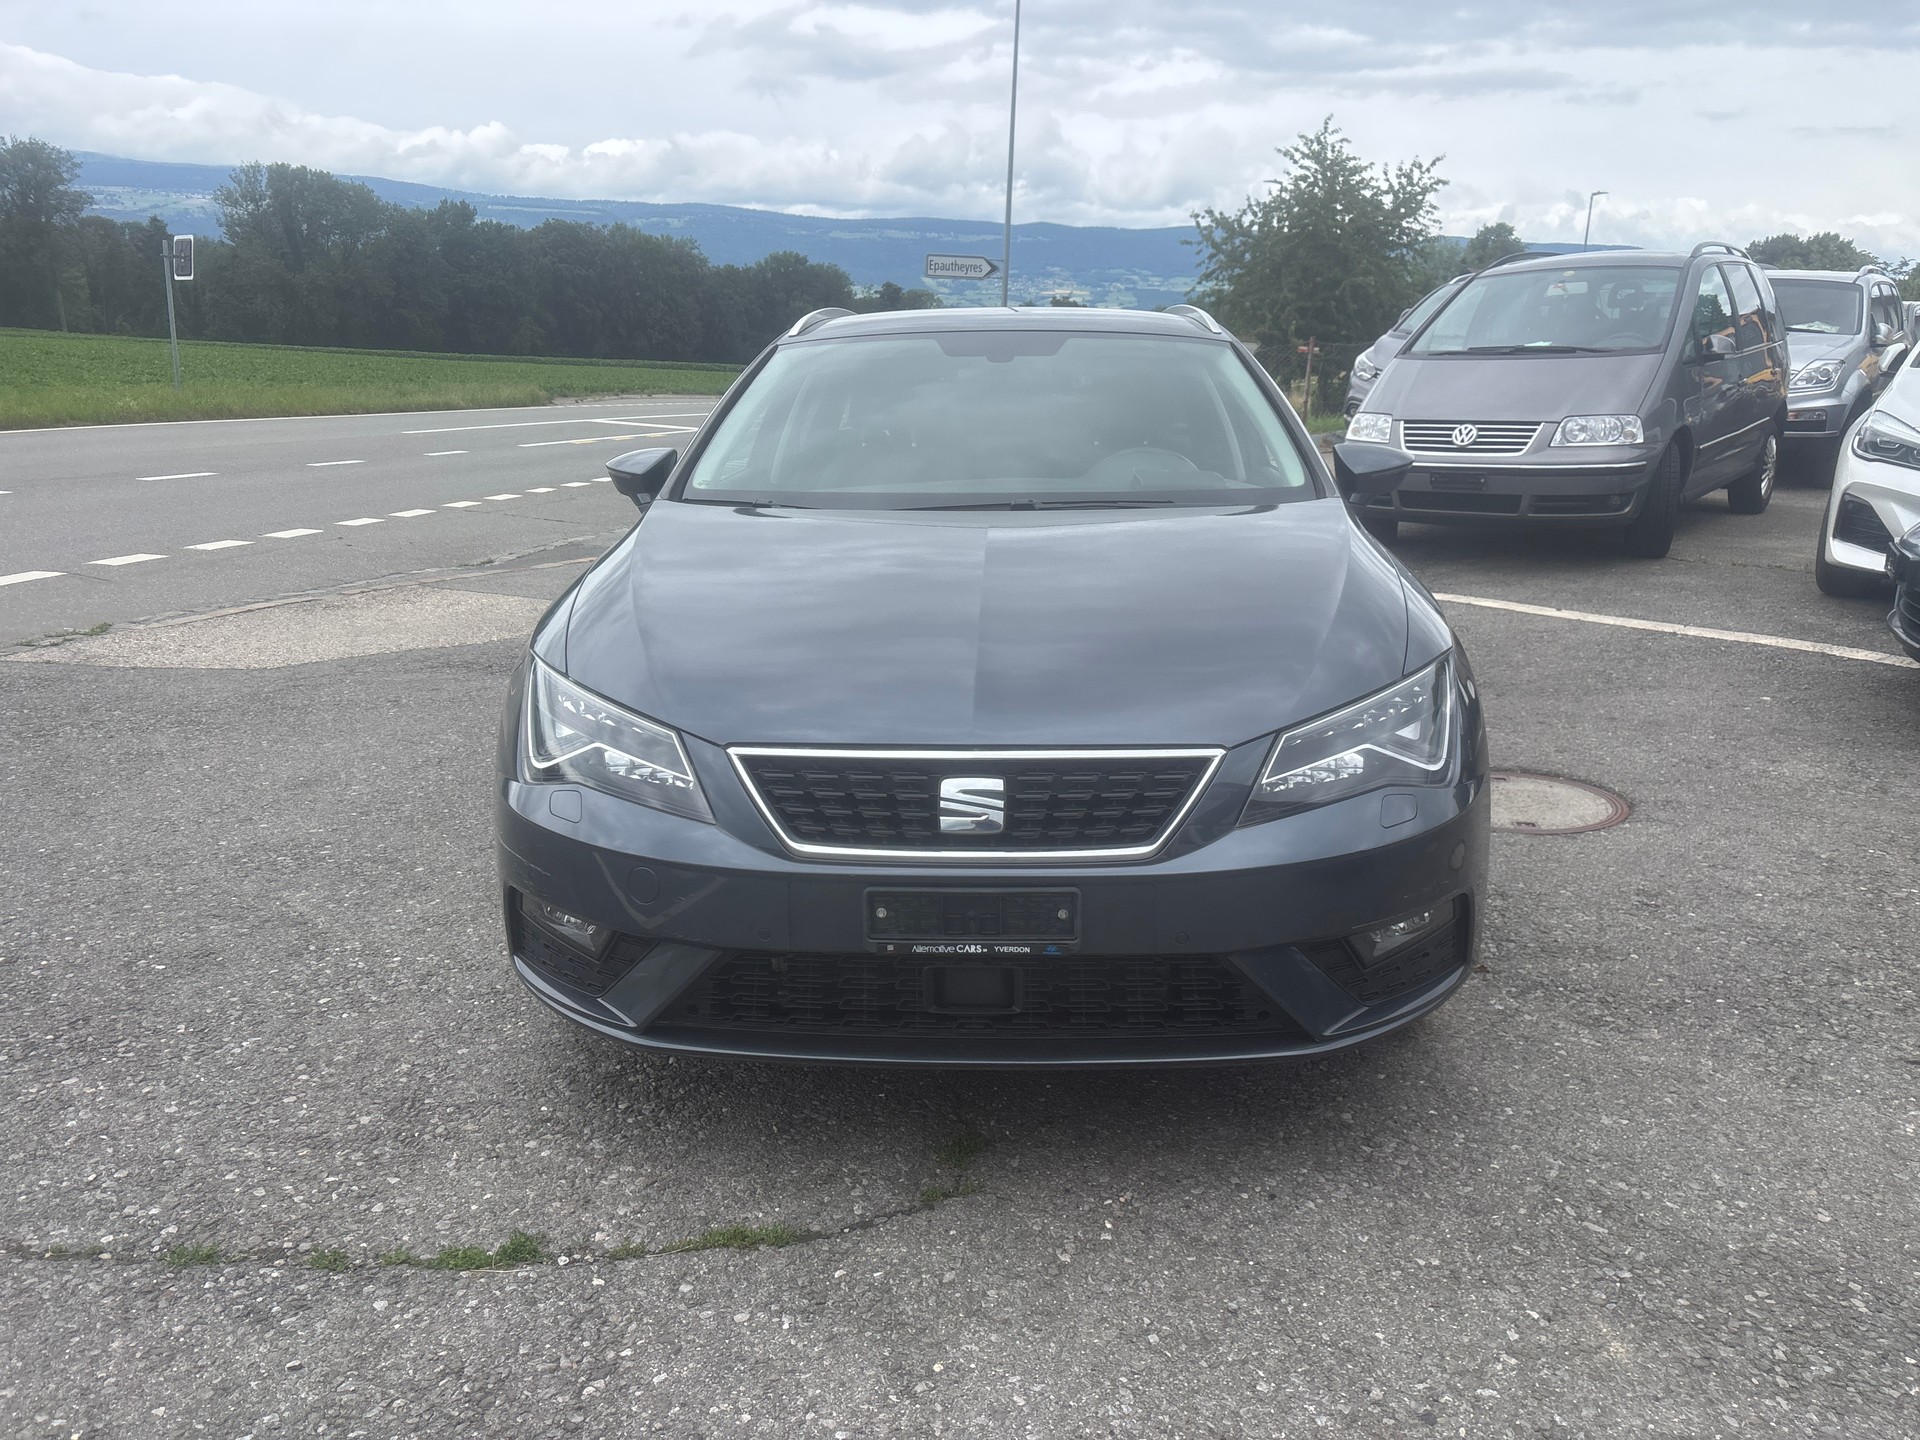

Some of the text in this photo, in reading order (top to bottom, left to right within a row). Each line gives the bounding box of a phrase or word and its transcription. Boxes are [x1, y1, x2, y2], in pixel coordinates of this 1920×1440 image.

[929, 259, 983, 275] Epautheyres
[956, 944, 982, 953] CARS
[994, 945, 1031, 953] YVERDON
